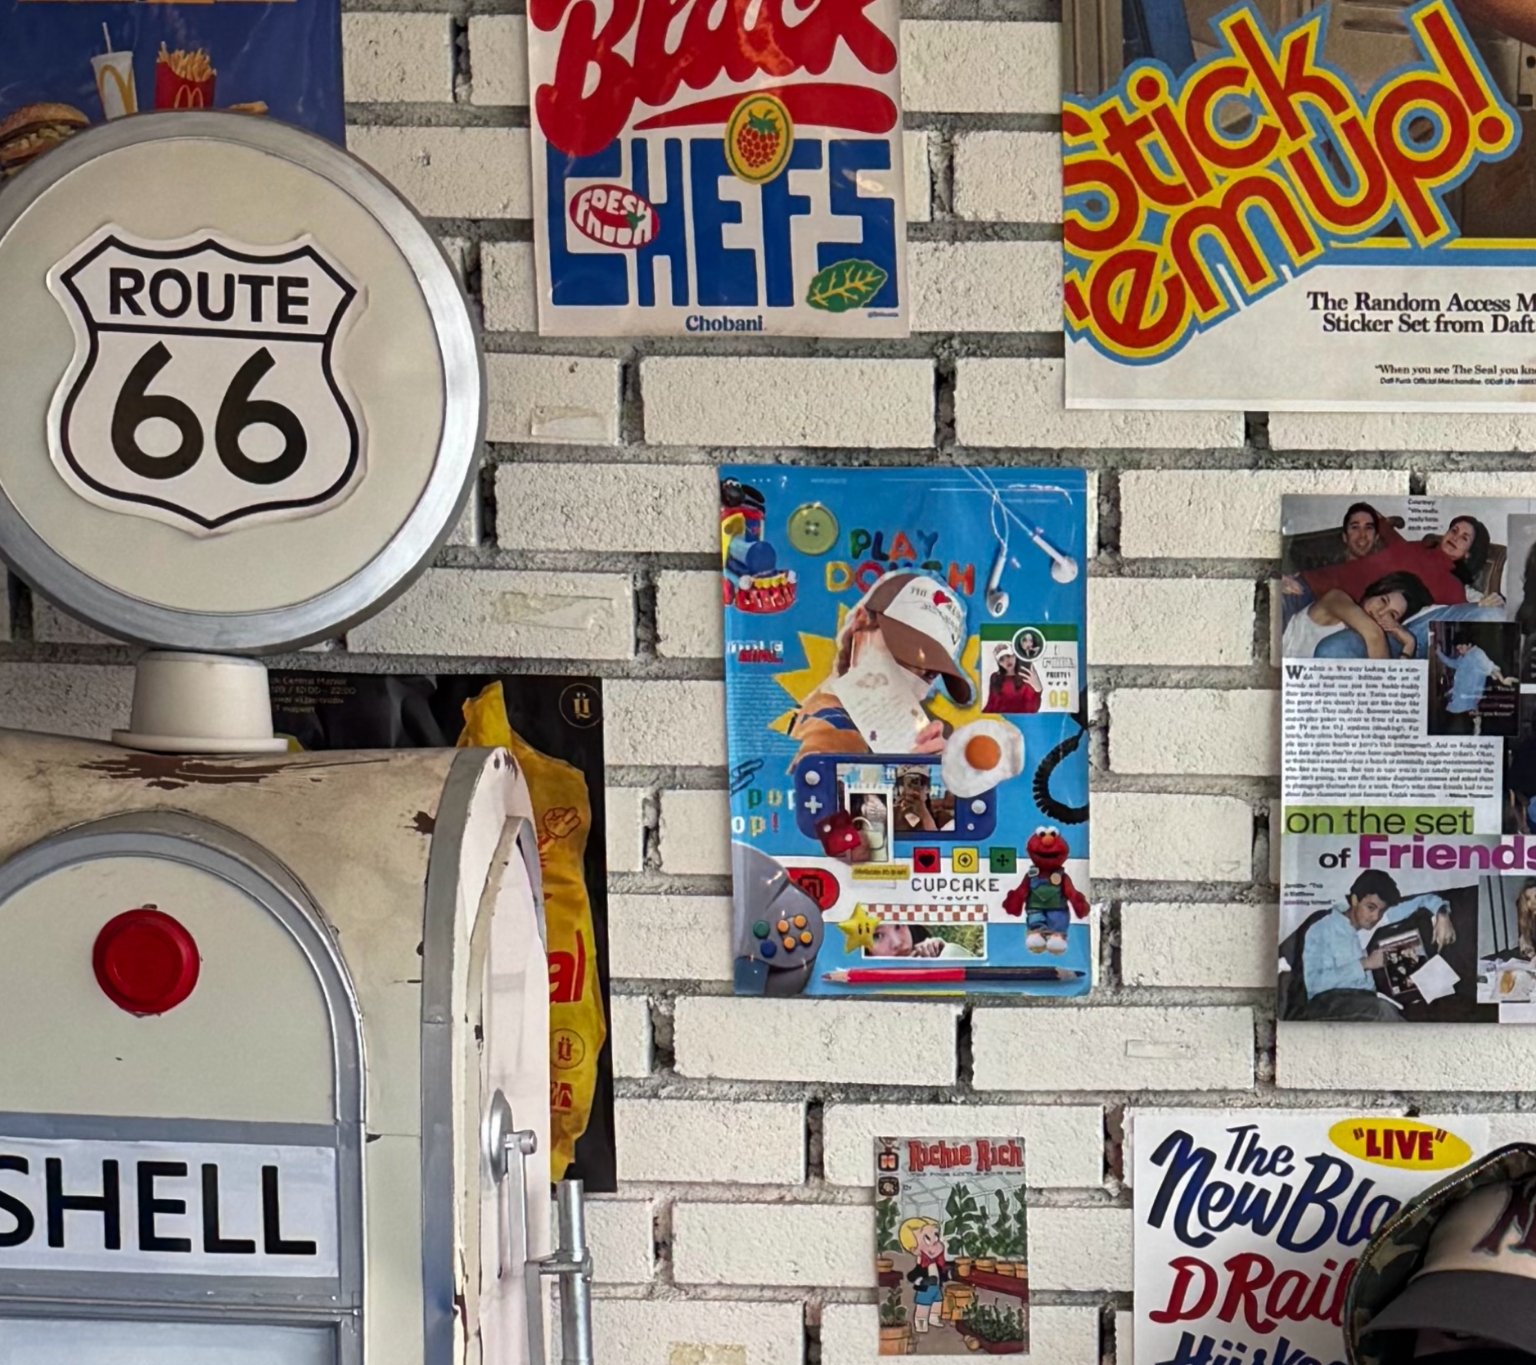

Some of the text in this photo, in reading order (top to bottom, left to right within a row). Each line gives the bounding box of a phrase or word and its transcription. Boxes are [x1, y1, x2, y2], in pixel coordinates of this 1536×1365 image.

[1286, 8, 1514, 247] up!
[546, 137, 900, 308] CHEFS
[109, 266, 310, 326] ROUTE
[1306, 291, 1349, 312] The
[1353, 291, 1441, 313] Random
[1446, 292, 1511, 313] Access
[685, 314, 764, 332] Chobani
[1322, 312, 1394, 334] Sticker
[1397, 313, 1431, 334] Set
[1434, 313, 1484, 334] from
[1490, 313, 1536, 334] Daft
[1411, 366, 1431, 376] you
[1433, 366, 1450, 375] see
[1452, 364, 1473, 375] The
[1474, 364, 1498, 375] Seal
[1500, 366, 1519, 376] you
[110, 340, 308, 486] 66
[849, 527, 939, 562] PLAY
[824, 560, 977, 597] DOH
[1285, 806, 1474, 836] on the set
[1318, 847, 1352, 869] of
[911, 877, 1000, 893] CUPCAKE
[908, 1139, 1025, 1172] Richie Rich
[1225, 1123, 1296, 1178] The
[1146, 1128, 1294, 1248] New
[0, 1156, 318, 1256] SHELL
